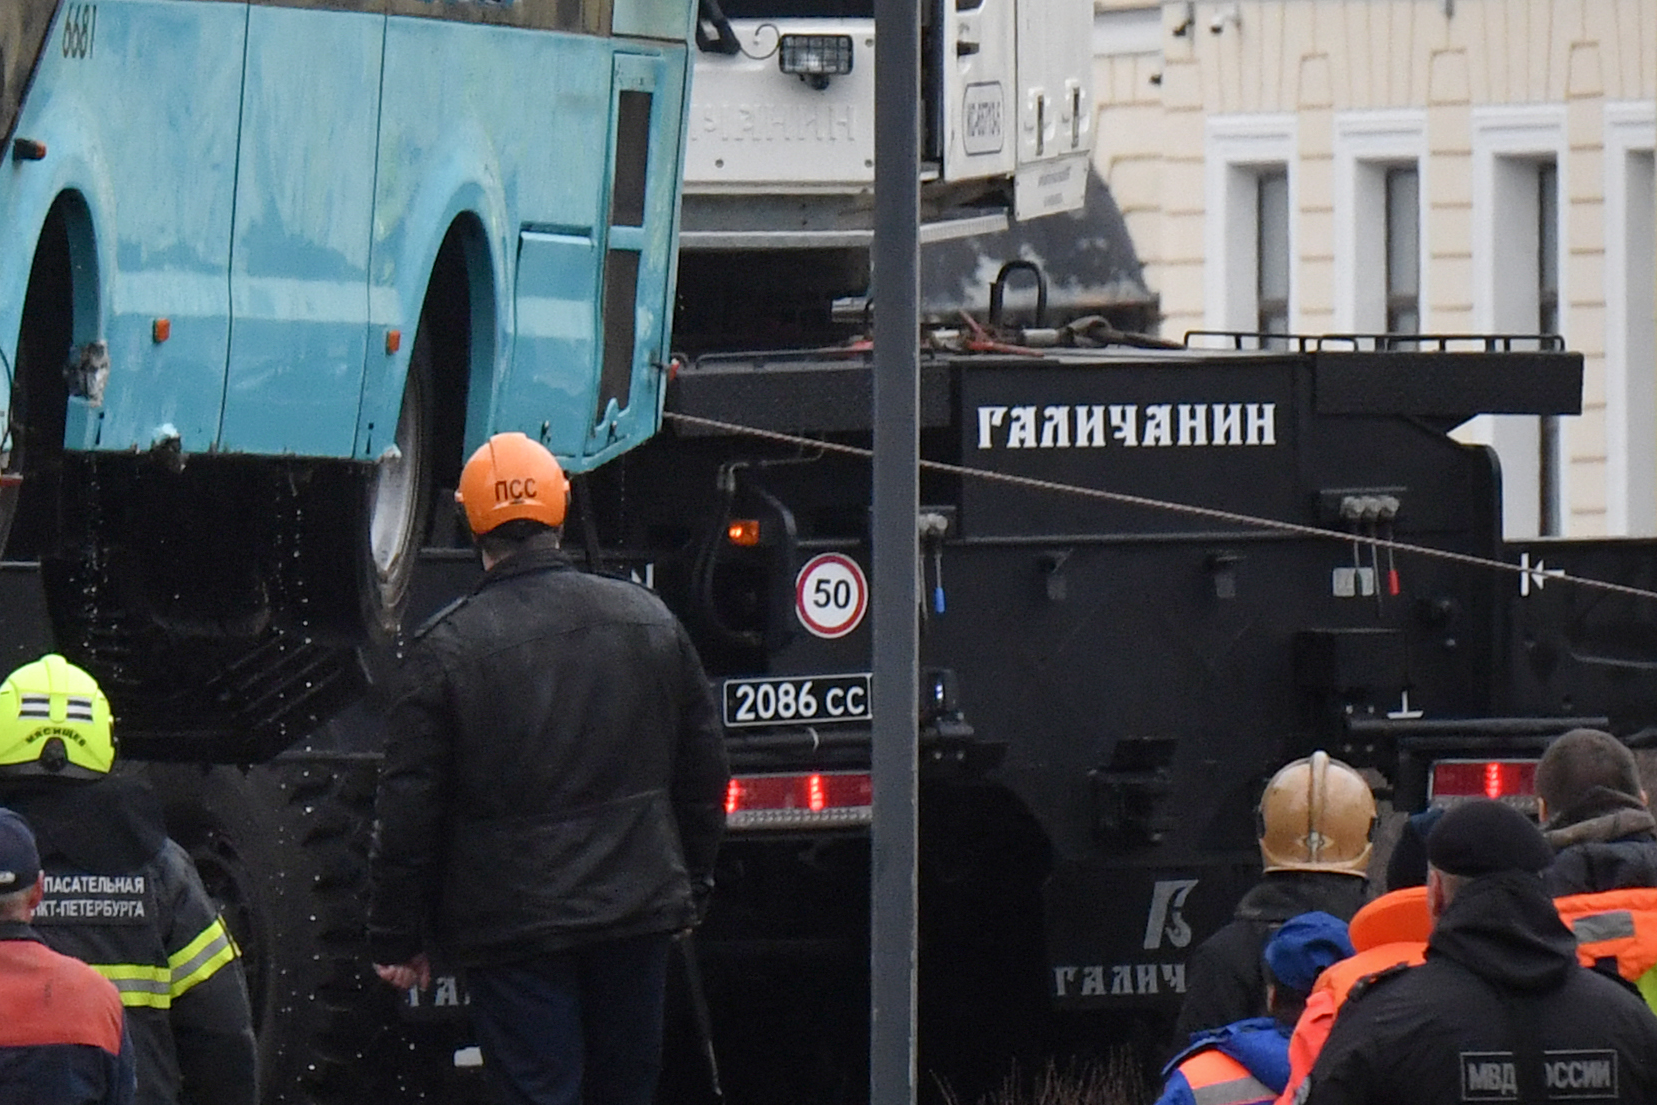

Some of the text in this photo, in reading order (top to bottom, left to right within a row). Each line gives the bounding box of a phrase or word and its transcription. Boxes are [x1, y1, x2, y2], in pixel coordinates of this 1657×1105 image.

[62, 2, 97, 59] 6681
[690, 103, 856, 142] ЧАНИН
[977, 403, 1276, 448] ГАЛИЧАНИН
[494, 478, 538, 501] ПСС
[813, 579, 851, 609] 50
[736, 681, 818, 721] 2086
[44, 876, 145, 894] ПАСАТЕЛЬНАЯ
[31, 899, 145, 917] НКТ-ПЕТЕРБУРГА
[1052, 963, 1187, 996] ГАЛИЧ
[1468, 1060, 1611, 1095] МВД ССИИ
